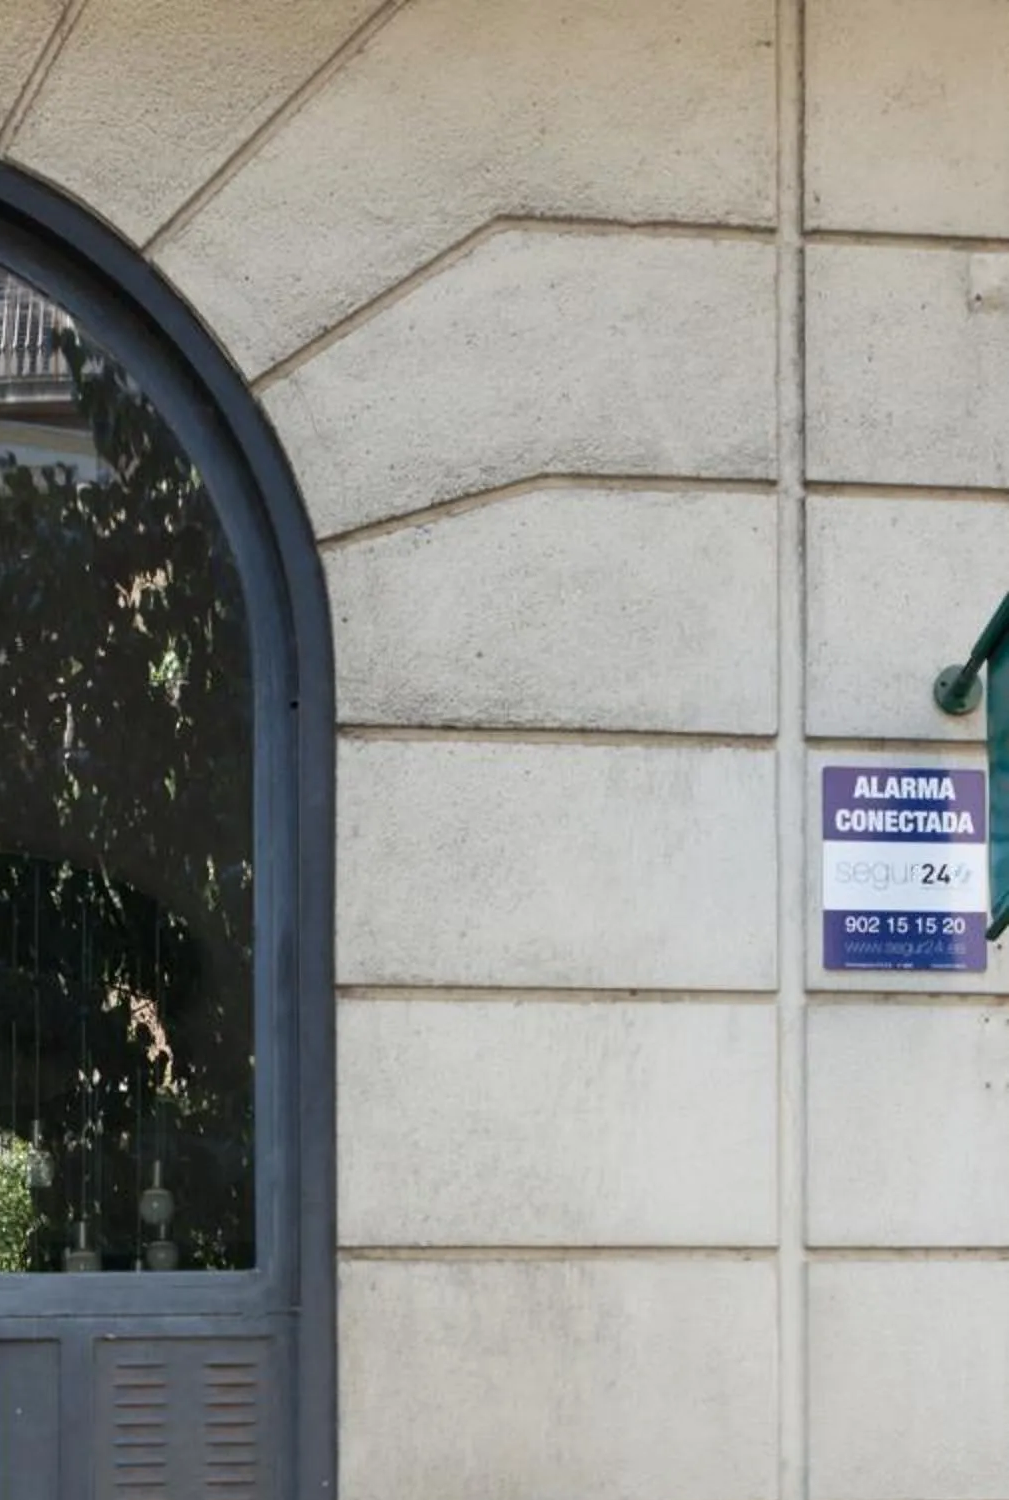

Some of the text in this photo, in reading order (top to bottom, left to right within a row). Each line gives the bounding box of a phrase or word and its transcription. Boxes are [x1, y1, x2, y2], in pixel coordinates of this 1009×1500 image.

[853, 776, 956, 800] ALARMA
[835, 809, 975, 833] CONECTADA
[845, 917, 966, 934] 902 15 15 20
